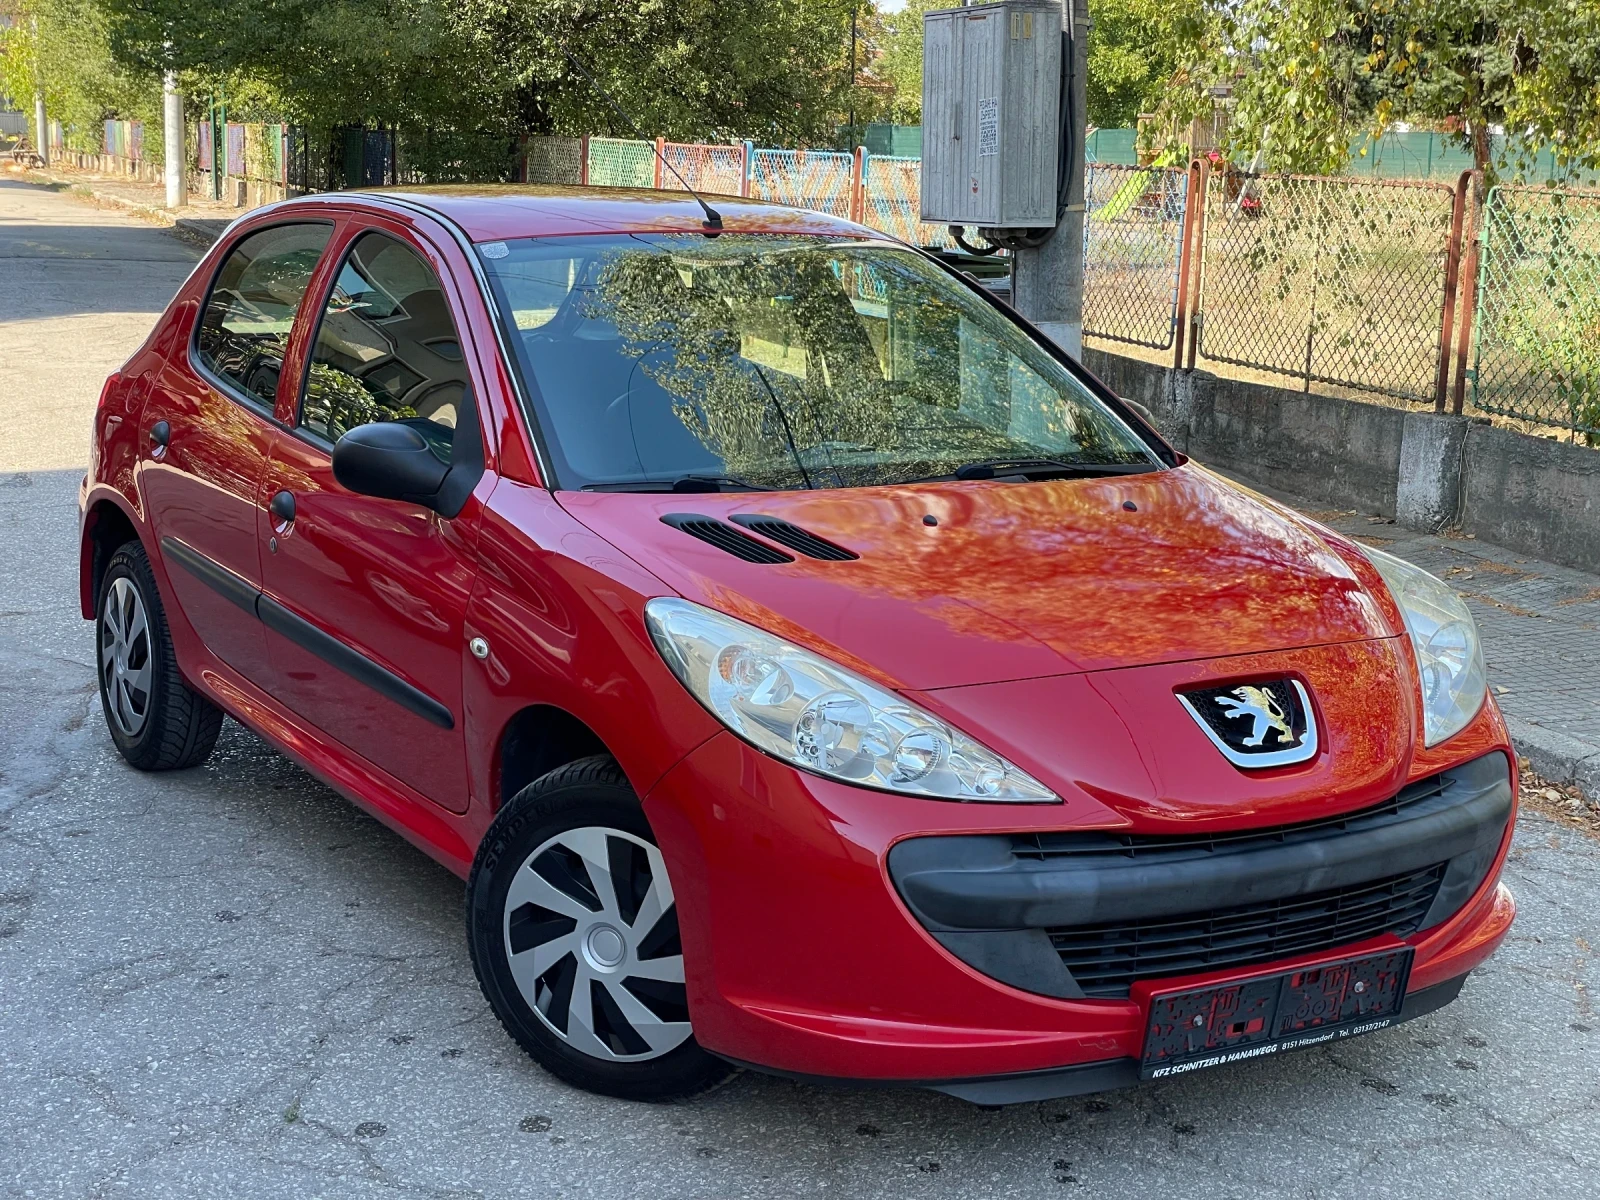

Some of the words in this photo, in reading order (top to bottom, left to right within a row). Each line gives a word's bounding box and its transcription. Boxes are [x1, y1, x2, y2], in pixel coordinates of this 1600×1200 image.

[1152, 1066, 1171, 1079] KFZ
[1171, 1056, 1219, 1074] SCHNITZER
[1219, 1055, 1227, 1064] &
[1227, 1044, 1278, 1062] HANAWEGG
[1281, 1041, 1298, 1050] 8151
[1298, 1031, 1335, 1047] Hitzendorf
[1339, 1029, 1350, 1038] Tel.
[1353, 1019, 1390, 1035] 03137/2147
